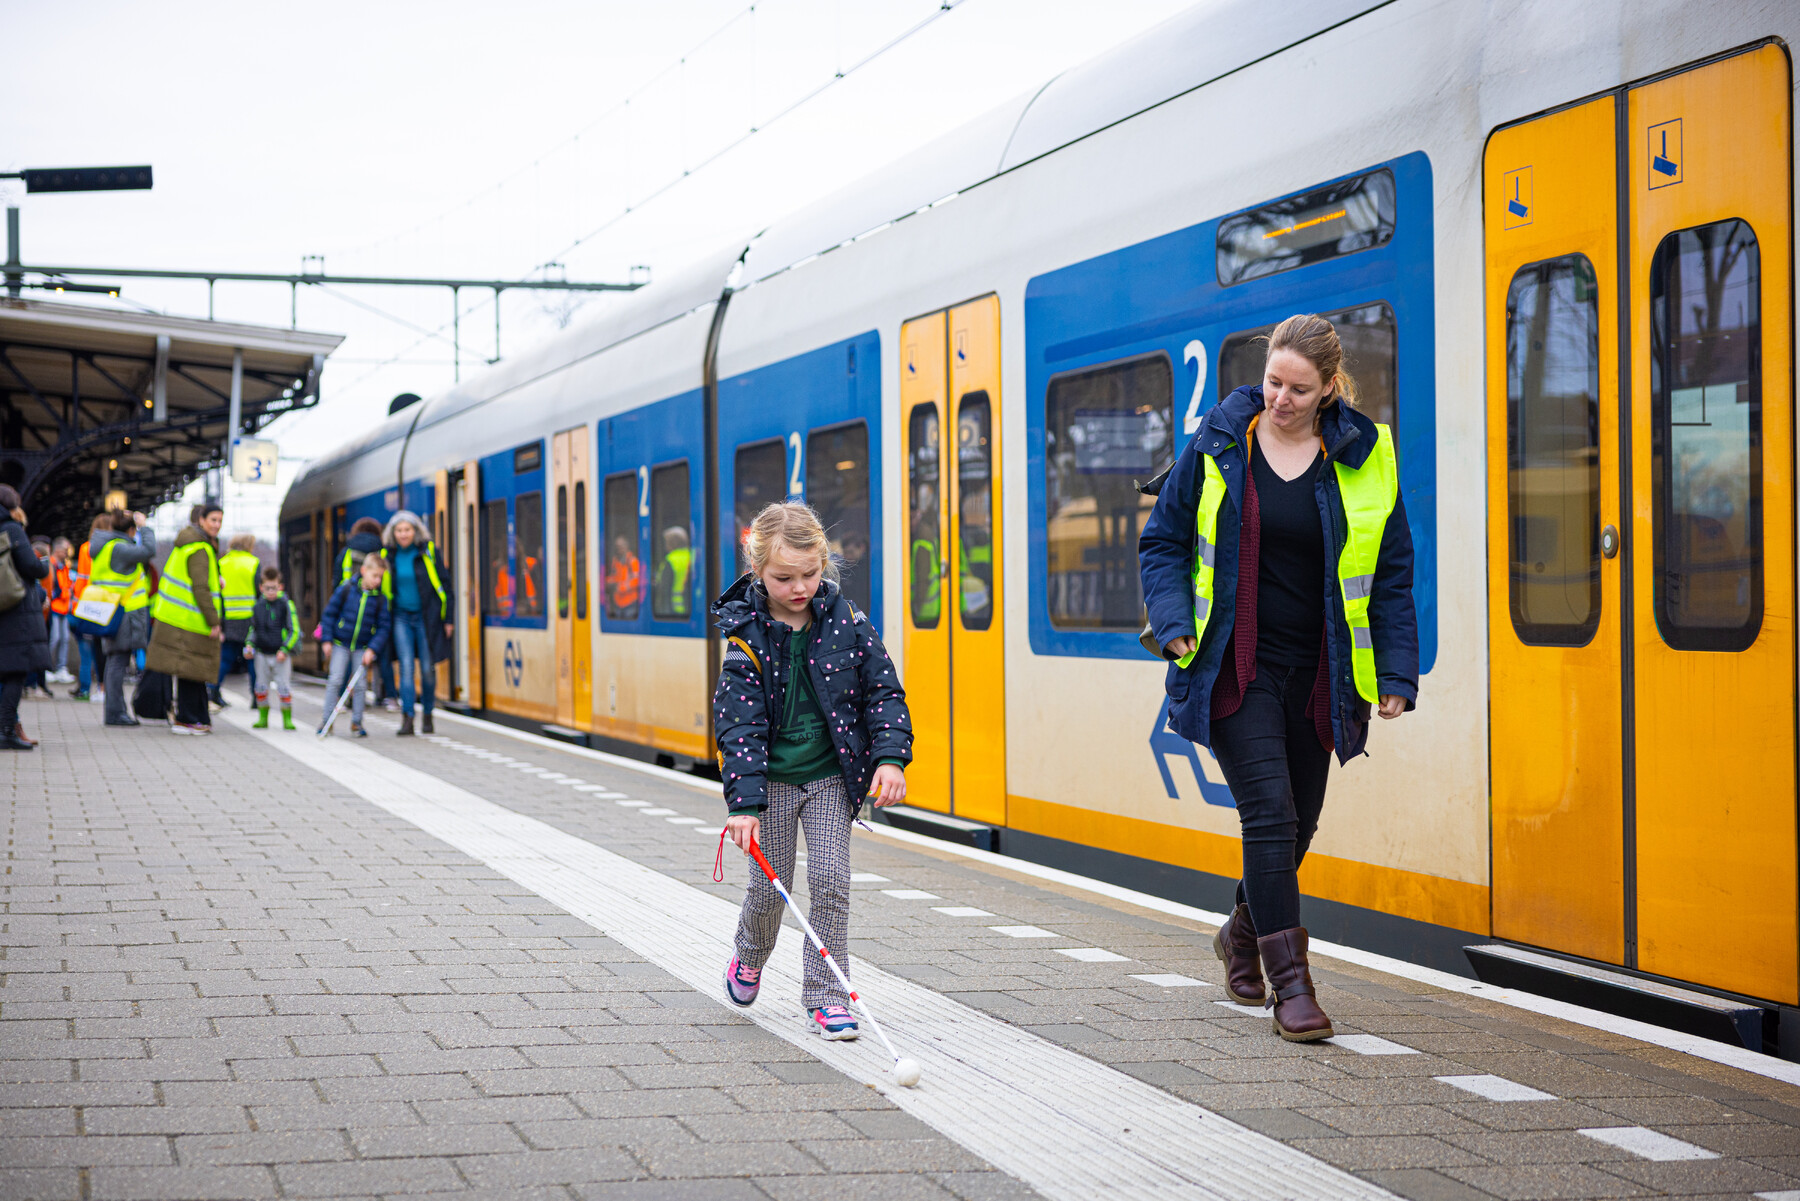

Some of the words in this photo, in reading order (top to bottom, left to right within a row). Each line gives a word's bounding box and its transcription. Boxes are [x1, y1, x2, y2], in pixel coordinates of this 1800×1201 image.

[1183, 339, 1208, 435] 2
[639, 465, 650, 517] 2
[789, 431, 803, 495] 2
